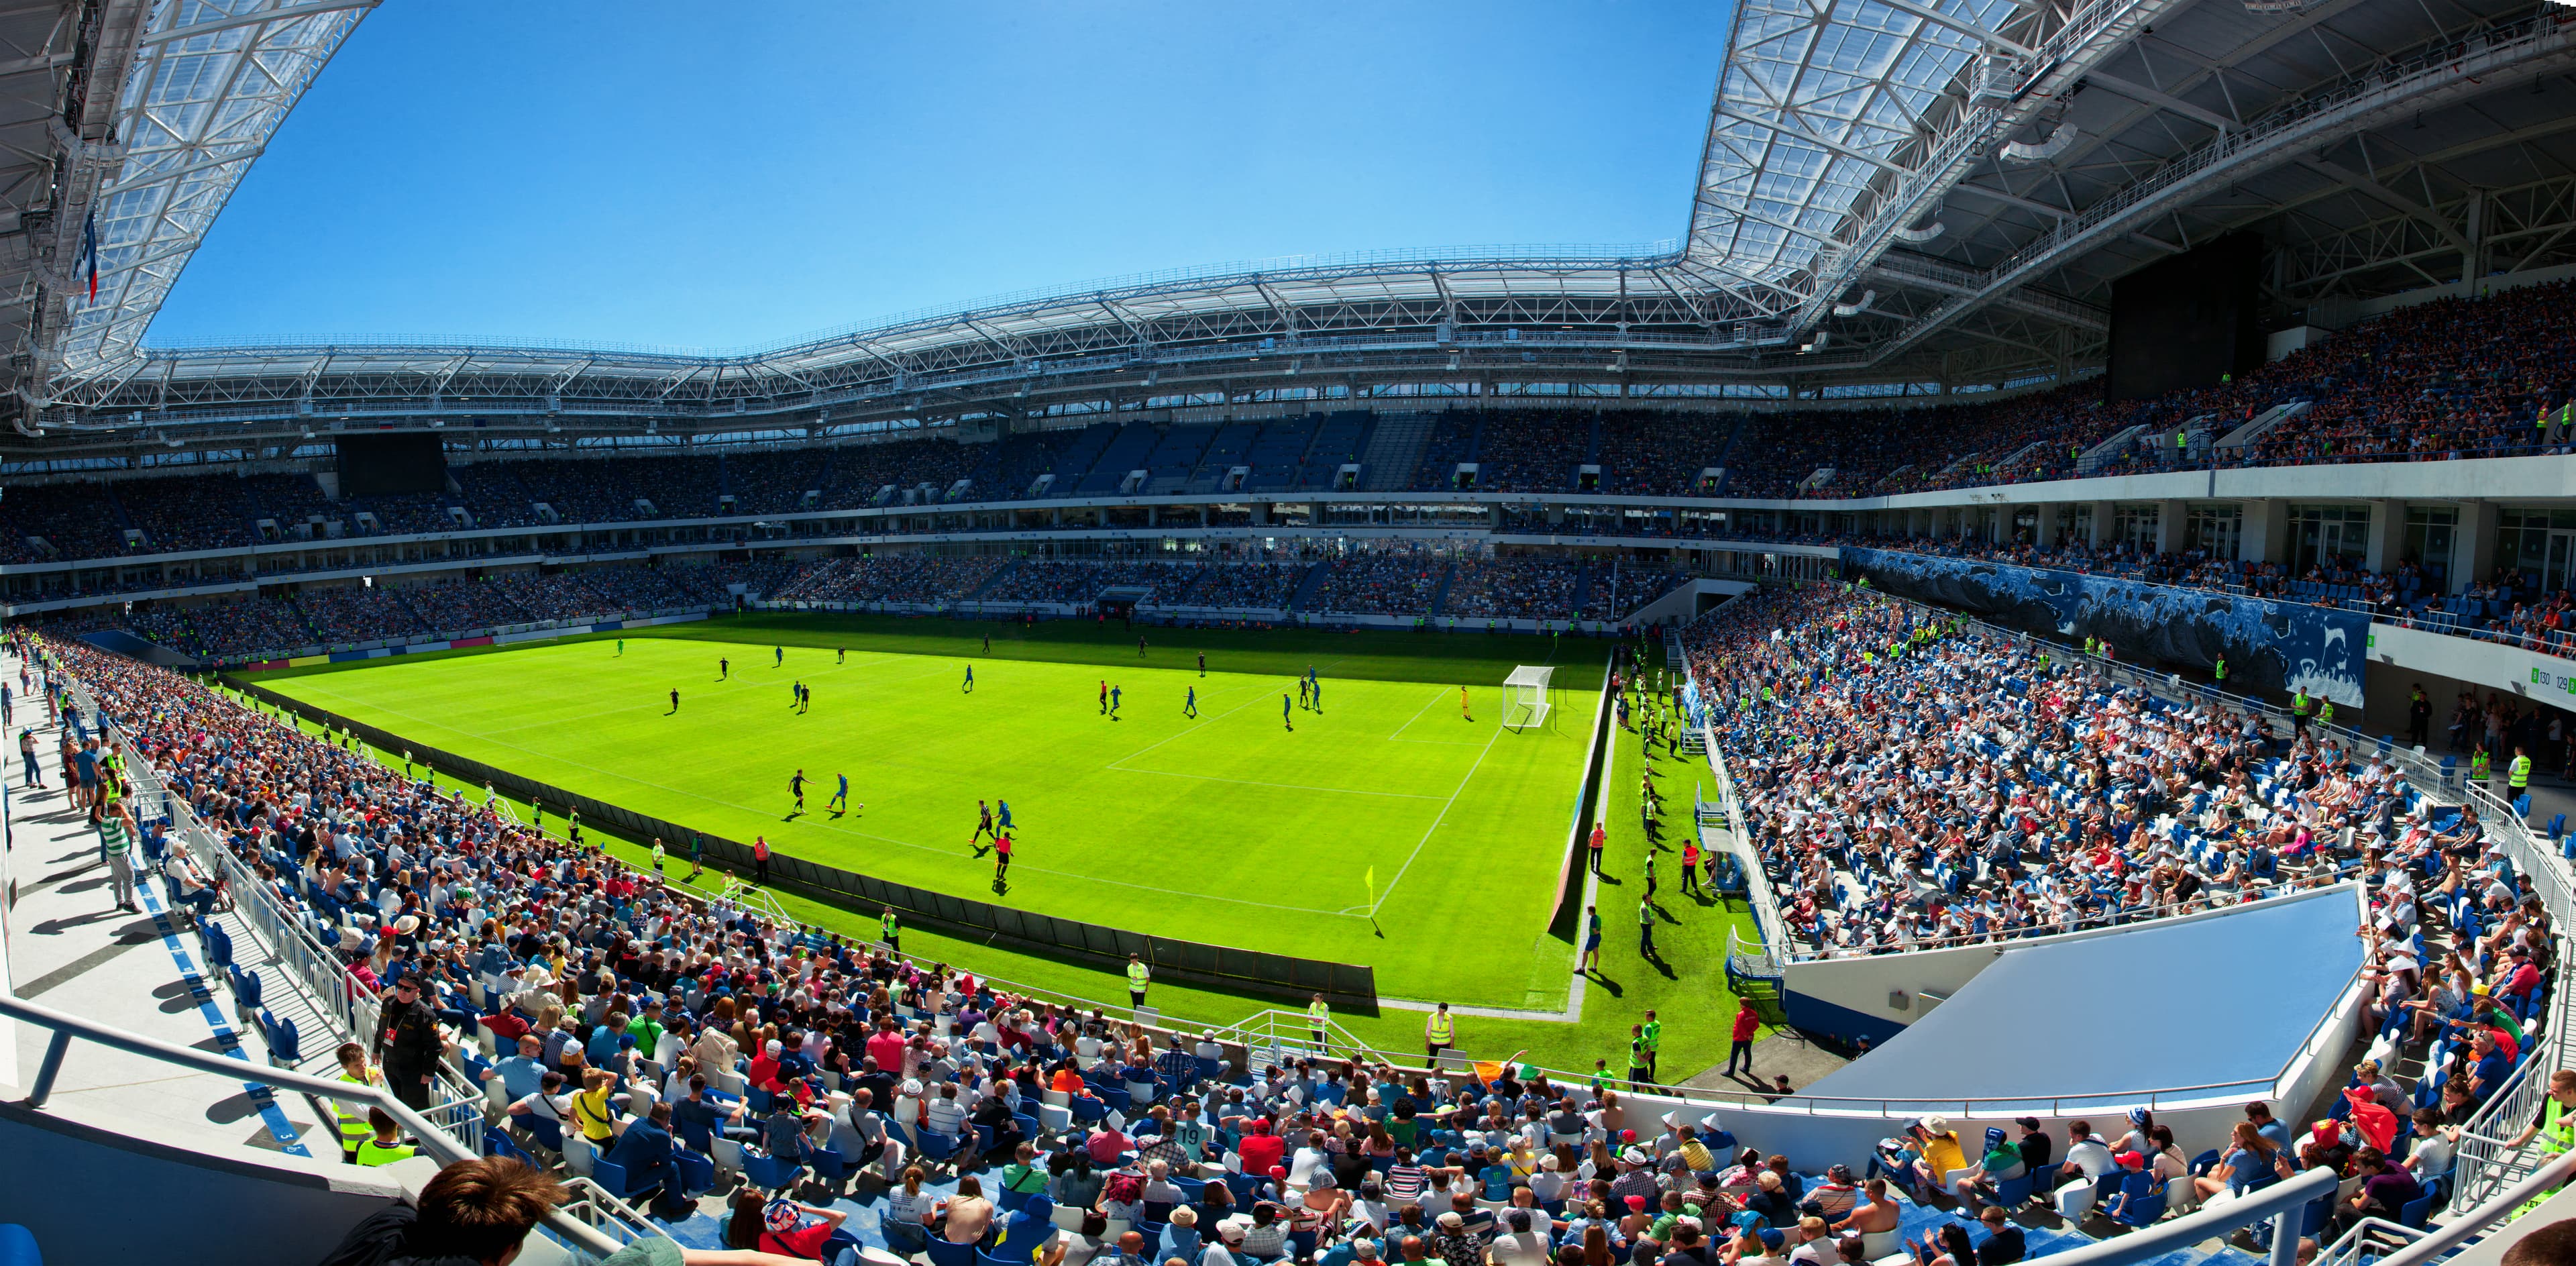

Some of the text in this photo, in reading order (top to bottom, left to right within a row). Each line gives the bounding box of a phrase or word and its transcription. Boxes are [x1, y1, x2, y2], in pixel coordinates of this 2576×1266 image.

[2539, 671, 2550, 685] 130
[2557, 676, 2568, 690] 129
[1181, 1128, 1199, 1145] 19
